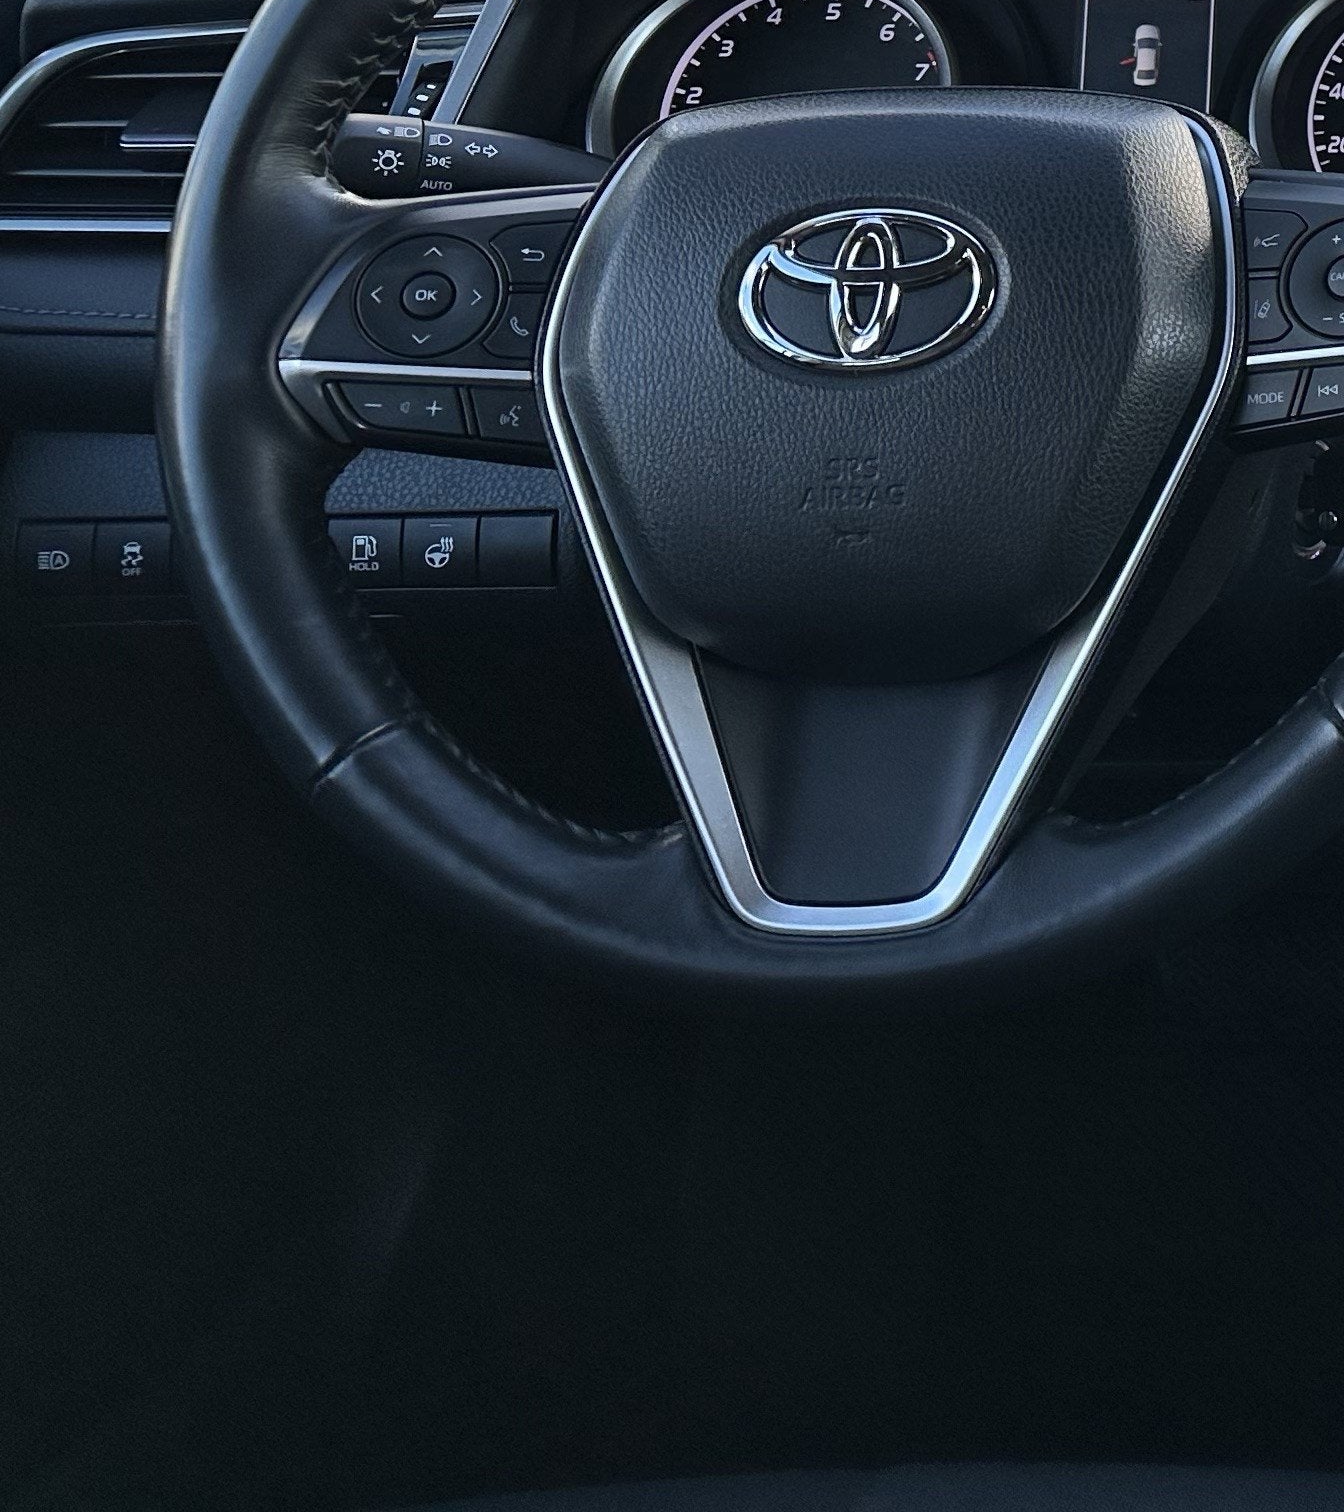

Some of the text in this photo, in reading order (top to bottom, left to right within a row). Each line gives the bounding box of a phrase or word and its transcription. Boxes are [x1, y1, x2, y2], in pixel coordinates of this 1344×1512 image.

[766, 6, 784, 26] 4
[825, 2, 842, 21] 5
[879, 23, 896, 42] 6
[716, 38, 736, 58] 3
[915, 63, 930, 81] 7
[685, 86, 703, 105] 2
[419, 179, 453, 191] AUTO
[414, 289, 438, 301] OK
[1247, 391, 1285, 405] MODE
[121, 566, 142, 577] OFF
[348, 561, 380, 572] HOLD
